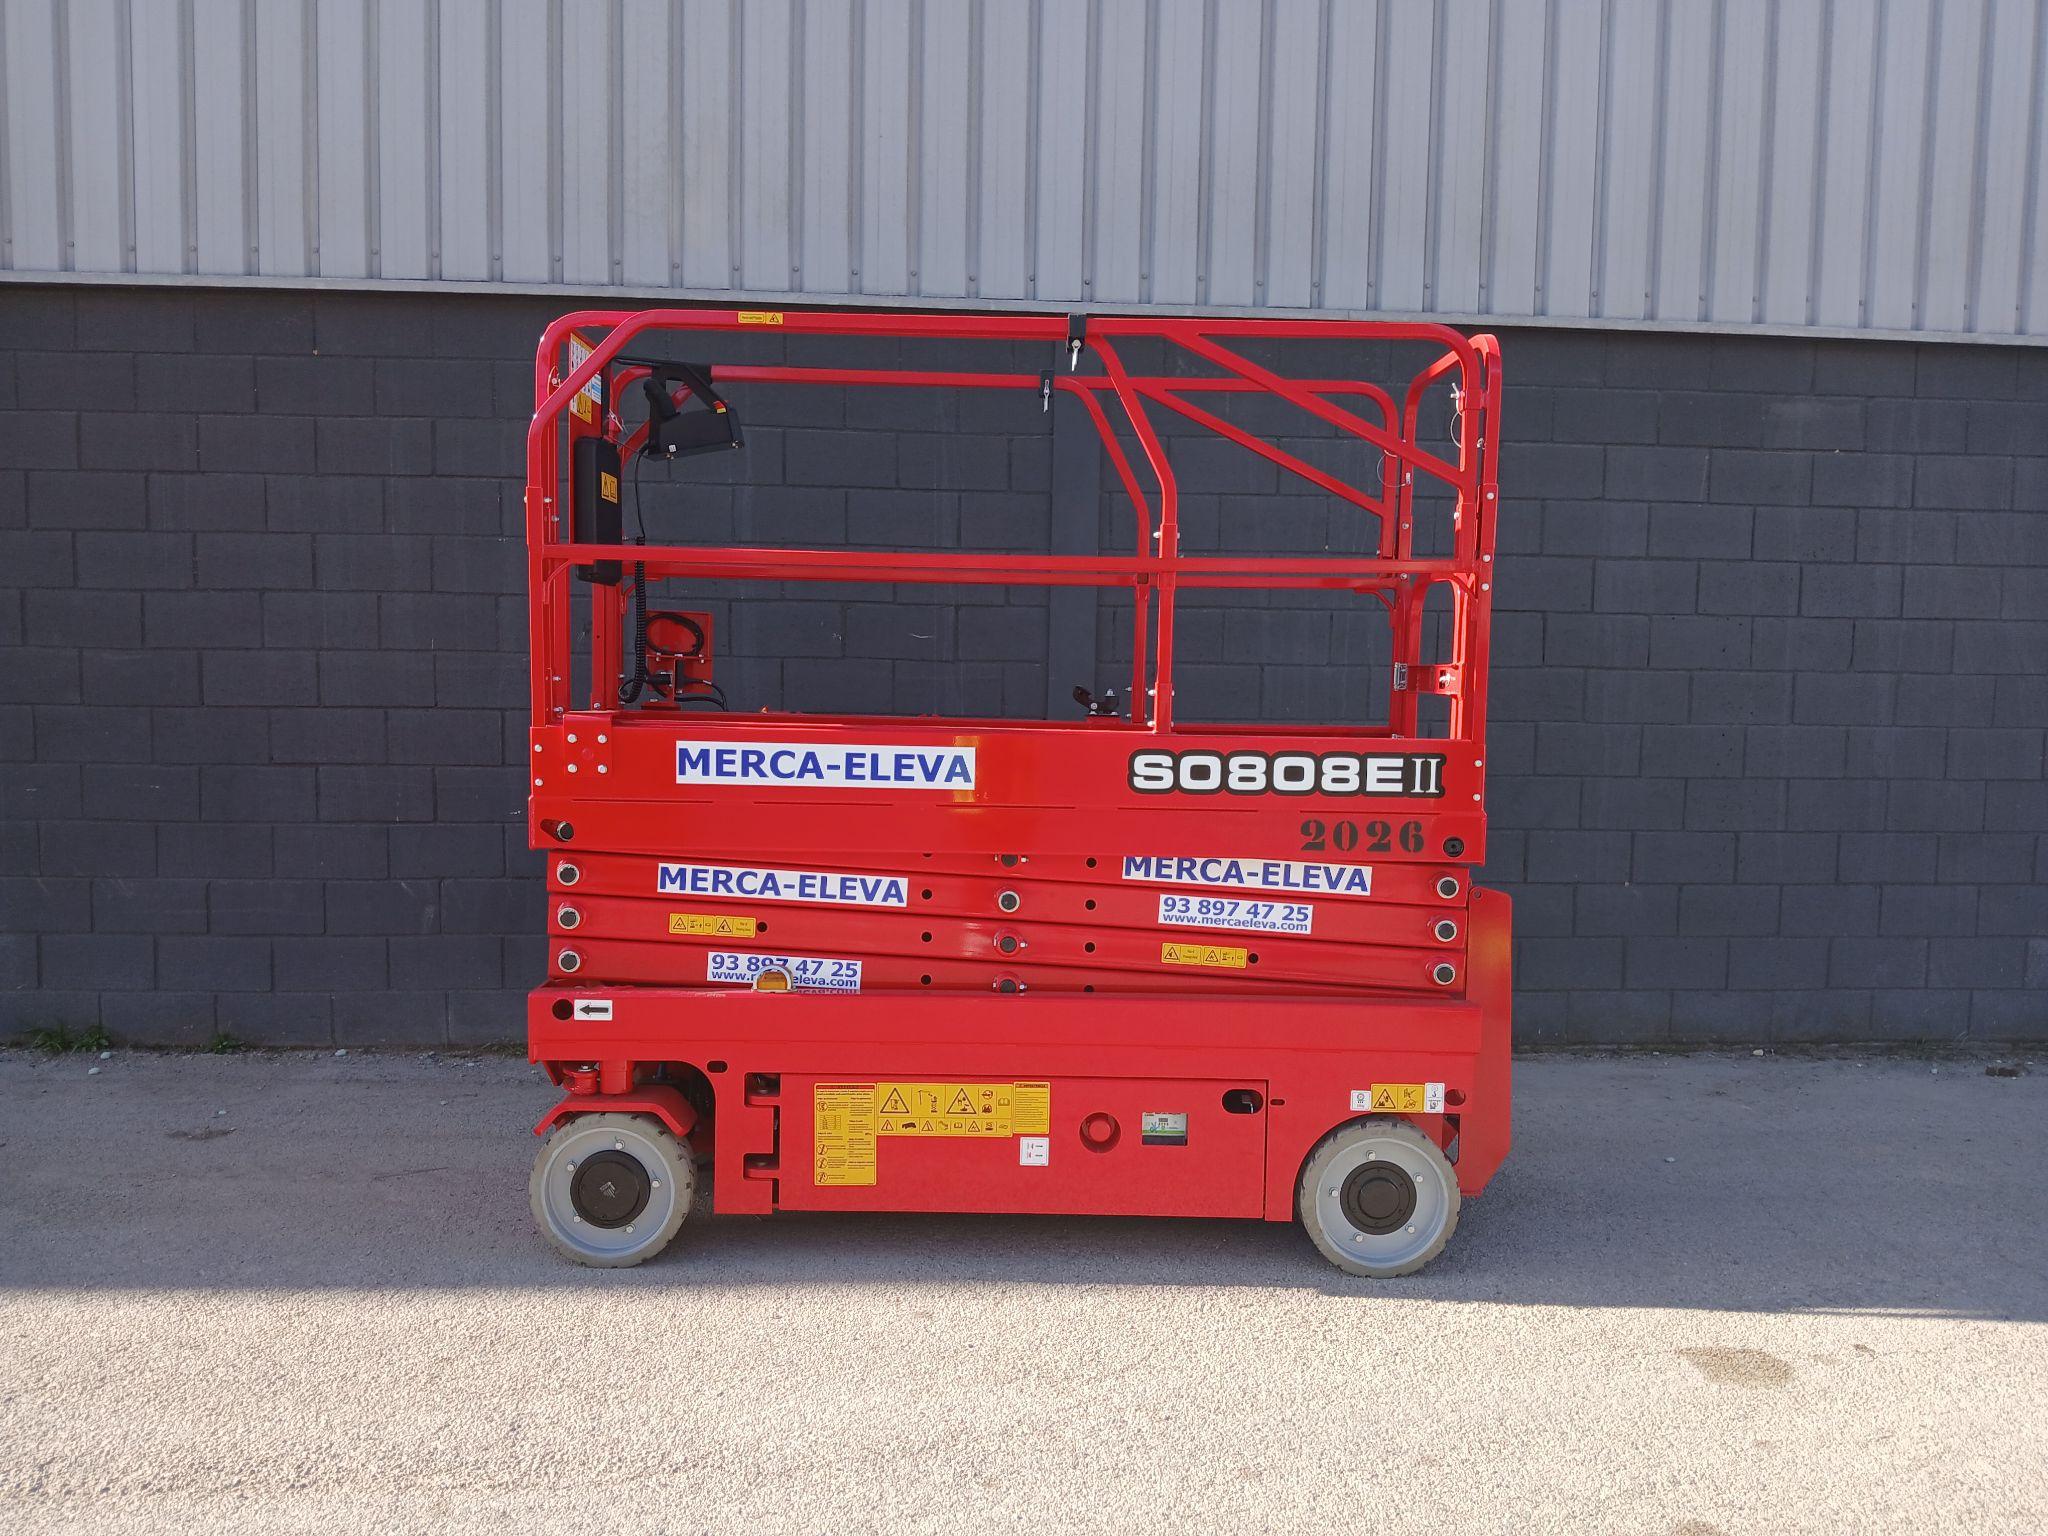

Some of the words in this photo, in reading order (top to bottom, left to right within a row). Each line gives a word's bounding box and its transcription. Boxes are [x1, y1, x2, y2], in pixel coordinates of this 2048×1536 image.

[677, 747, 973, 784] MERCA-ELEVA
[1300, 819, 1425, 853] 2026
[659, 866, 905, 904] MERCA-ELEVA
[1123, 857, 1369, 893] MERCA-ELEVA
[1162, 913, 1308, 932] www.mercaeleva.com
[1163, 897, 1190, 914] 93
[1197, 899, 1240, 917] 897
[1246, 903, 1275, 920] 47
[1281, 905, 1310, 922] 25
[711, 953, 739, 970] 93
[795, 960, 824, 976] 47
[831, 961, 859, 978] 25
